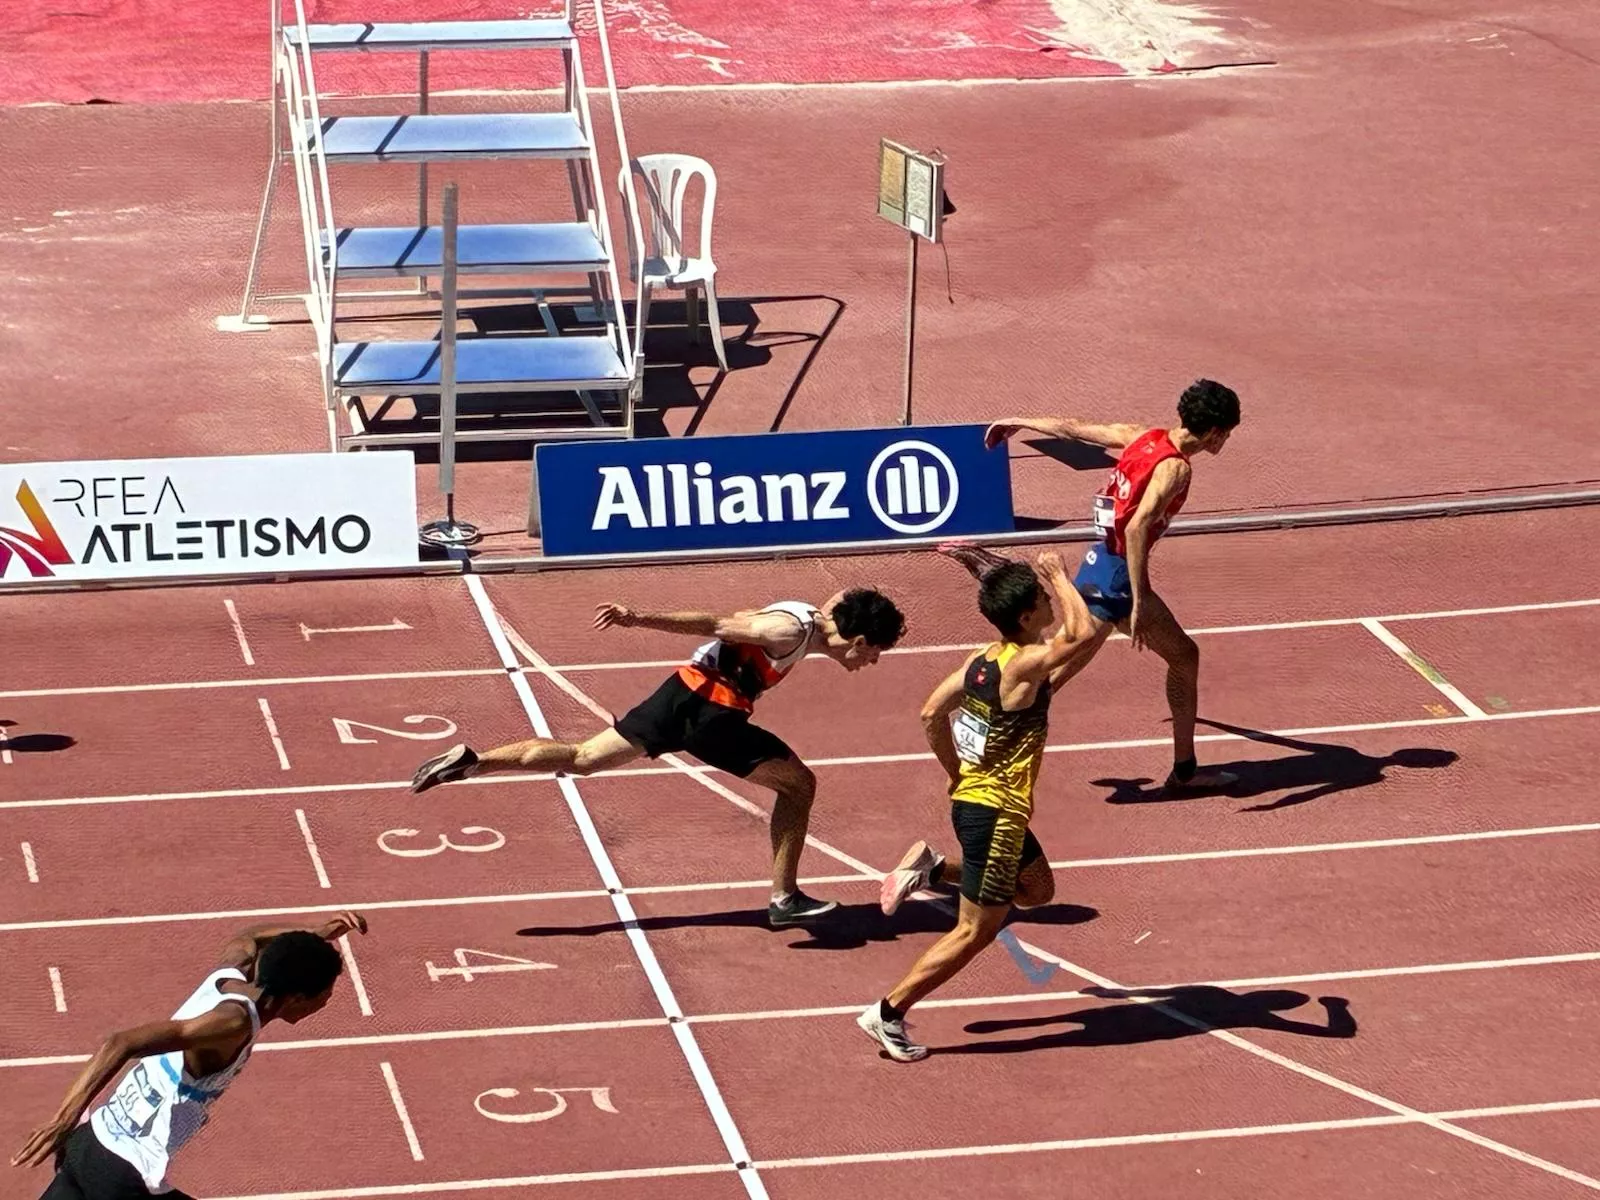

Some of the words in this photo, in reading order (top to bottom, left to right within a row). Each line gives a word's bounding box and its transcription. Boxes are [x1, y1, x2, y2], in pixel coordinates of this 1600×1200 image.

[53, 476, 185, 517] RFEA
[591, 461, 850, 531] Allianz
[82, 514, 371, 564] ATLETISMO
[300, 617, 414, 642] 1
[332, 714, 458, 745] 2
[376, 825, 506, 858] 3
[425, 947, 559, 983] 4
[473, 1086, 620, 1123] 5
